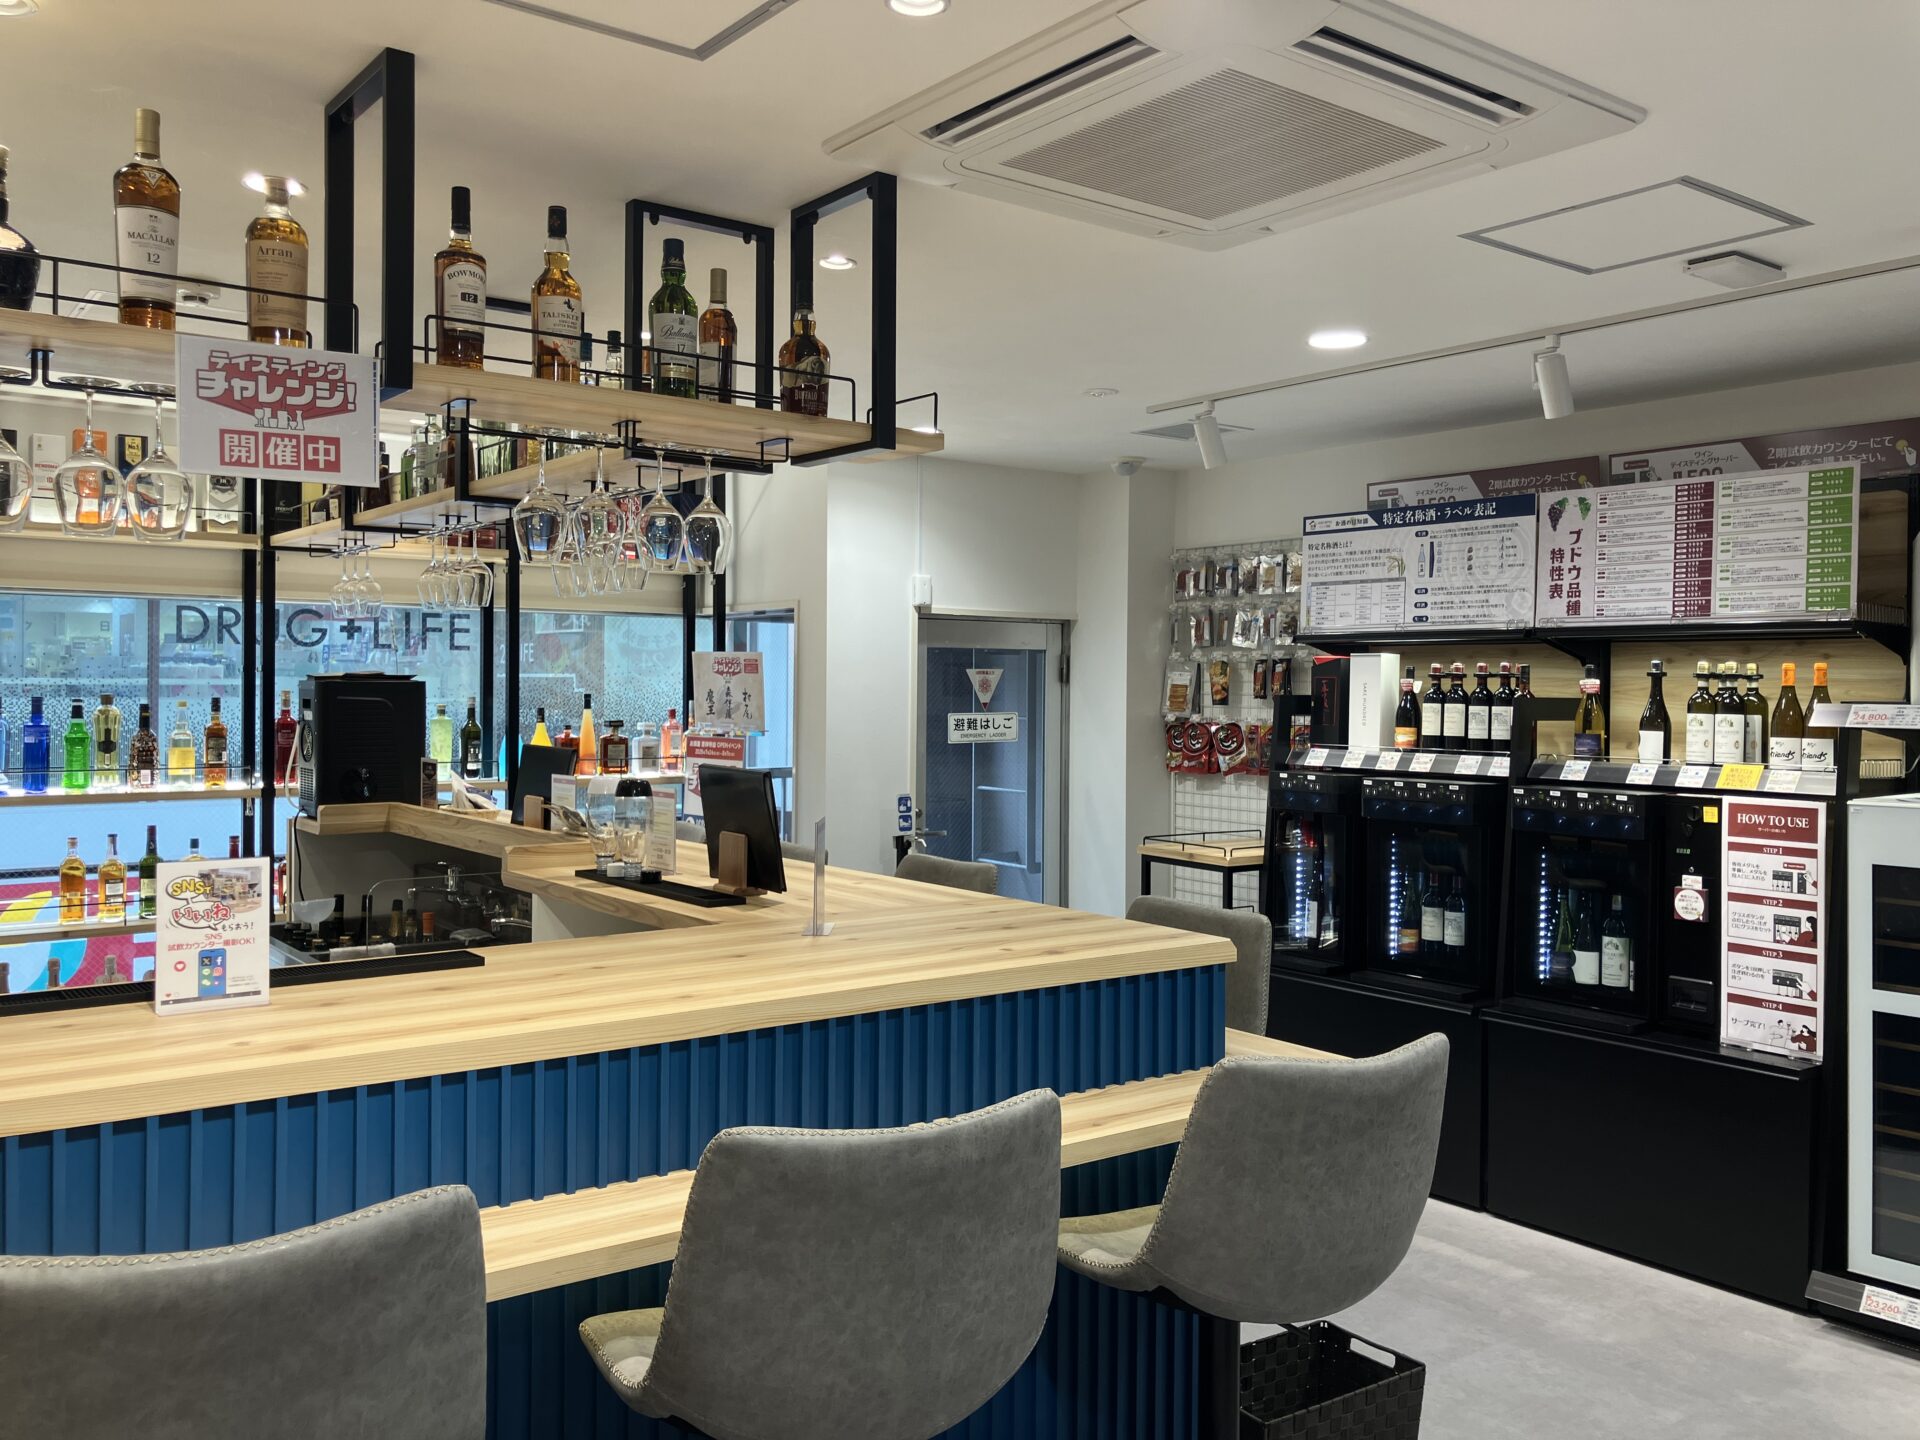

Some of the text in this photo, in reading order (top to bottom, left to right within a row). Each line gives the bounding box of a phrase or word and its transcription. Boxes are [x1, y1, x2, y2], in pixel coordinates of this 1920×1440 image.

[127, 231, 175, 246] MACALLAN
[146, 252, 160, 263] 12
[257, 245, 293, 258] Arran
[257, 294, 269, 304] 10
[464, 293, 475, 302] 12
[209, 350, 345, 380] テイスティング
[197, 369, 356, 412] チャレンジ!
[223, 433, 336, 469] 開催中
[1767, 436, 1894, 460] 2階試飲カウンターにて
[1488, 471, 1578, 491] 2階試飲カウンターにて
[1382, 502, 1497, 525] 特定名称酒・ラベル表記
[1307, 541, 1353, 551] 特定名称酒とは?
[1549, 547, 1565, 600] 特性表
[1566, 528, 1584, 616] ブドウ品種
[176, 604, 471, 651] DRG+LIFE
[705, 688, 715, 716] 魔王
[953, 716, 1014, 732] 避難はしご
[1737, 812, 1810, 829] HOW TO USE
[1762, 847, 1778, 855] STEP
[167, 939, 256, 952] 試飲カウンター撮影OK!
[1761, 950, 1778, 958] STEP
[1761, 1001, 1778, 1009] STEP
[1731, 1017, 1766, 1030] サーブ完了!
